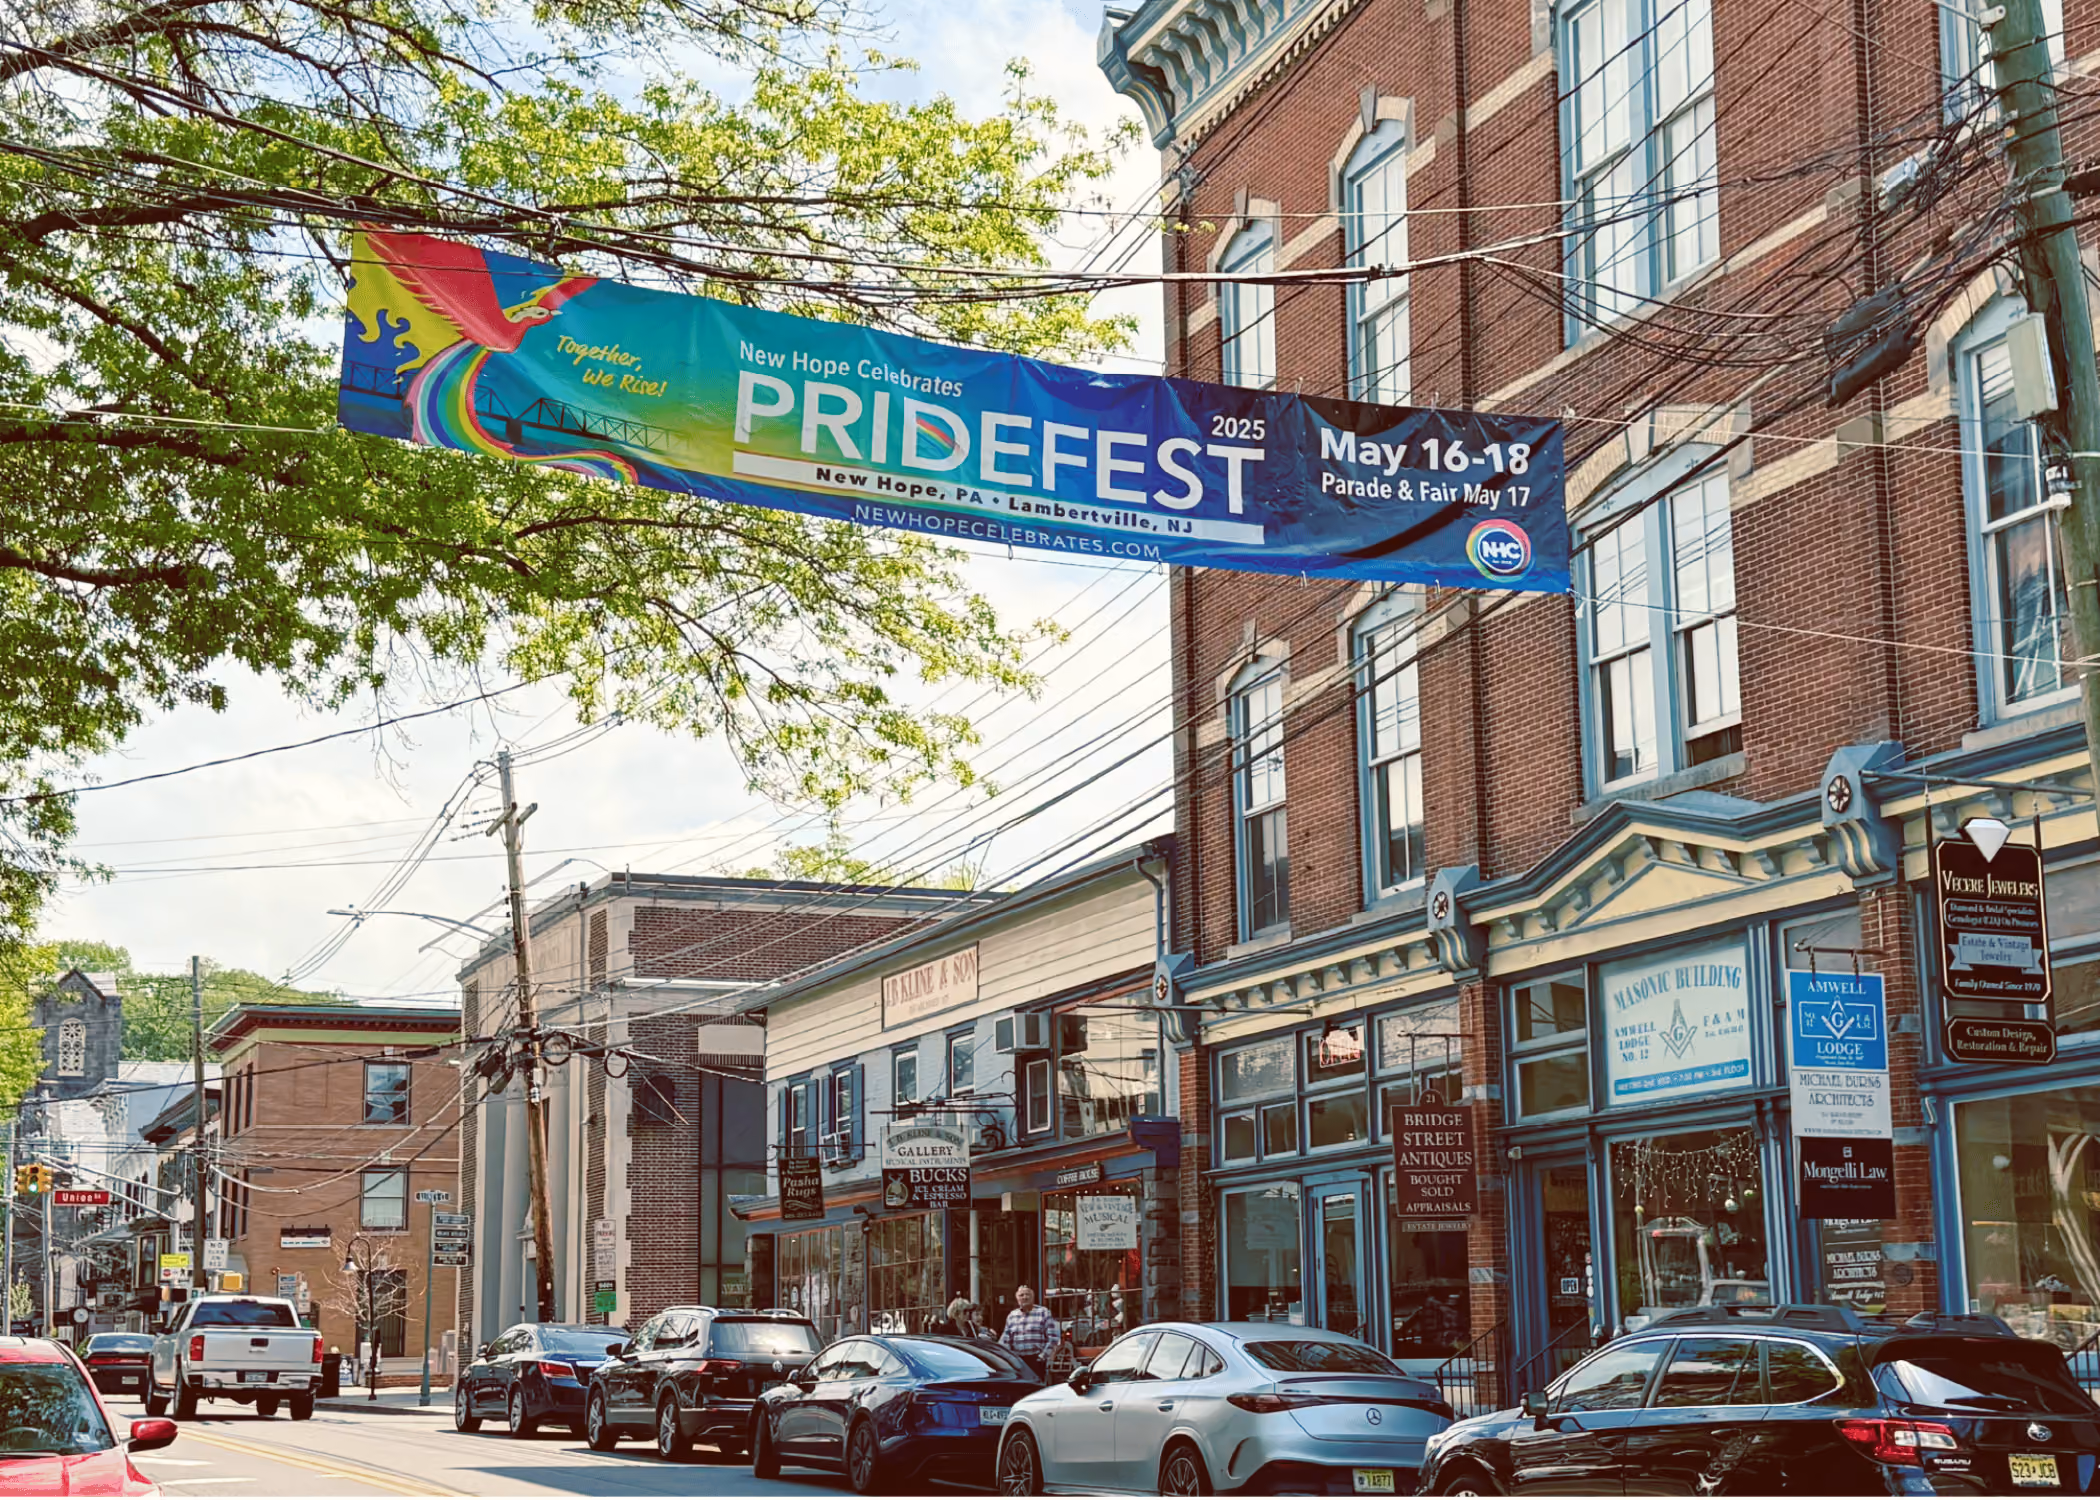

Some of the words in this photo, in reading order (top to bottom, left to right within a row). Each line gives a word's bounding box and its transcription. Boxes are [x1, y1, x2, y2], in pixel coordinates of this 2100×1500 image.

[557, 335, 642, 372] Together,
[739, 340, 786, 369] New
[792, 351, 851, 379] Hope
[857, 360, 964, 398] Celebrates
[582, 368, 615, 388] We
[619, 374, 669, 398] Rise!
[1211, 415, 1266, 440] 2025
[733, 369, 1266, 515] PRIDEFEST
[1320, 427, 1408, 477] May
[1421, 438, 1531, 475] 16-18
[1321, 471, 1393, 499] Parade
[1399, 479, 1414, 501] &
[1419, 481, 1458, 502] Fair
[1463, 483, 1501, 511] May
[1506, 486, 1531, 507] 17
[816, 467, 869, 486] New
[877, 476, 946, 500] Hope,
[956, 487, 984, 504] PA
[1008, 497, 1159, 532] Lambertville,
[1167, 518, 1194, 534] NJ
[855, 503, 1160, 559] NEWHOPECELEBRATES.COM
[1481, 540, 1522, 560] NHC
[1613, 970, 1671, 1011] MASONIC
[1675, 964, 1742, 990] BUILDING
[1807, 980, 1867, 995] AMWELL
[1831, 1011, 1844, 1028] G
[1673, 1026, 1684, 1041] G
[1816, 1041, 1864, 1055] LODGE
[1808, 1092, 1875, 1107] ARCHITECTS
[1403, 1113, 1464, 1126] BRIDGE
[1403, 1131, 1465, 1147] STREET
[897, 1146, 954, 1157] GALLERY
[1400, 1151, 1473, 1169] ANTIQUES
[909, 1168, 967, 1184] BUCKS
[1410, 1174, 1463, 1185] BOUGHT
[1803, 1161, 1857, 1184] Mongelli
[1860, 1161, 1888, 1179] Law
[783, 1175, 819, 1189] Pasha
[914, 1184, 929, 1193] ICE
[931, 1184, 965, 1193] CREAM
[62, 1192, 93, 1203] Union
[787, 1187, 817, 1199] Rugs
[923, 1192, 967, 1200] ESPRESSO
[1420, 1186, 1454, 1197] SOLD
[1406, 1201, 1472, 1212] APPRAISALS
